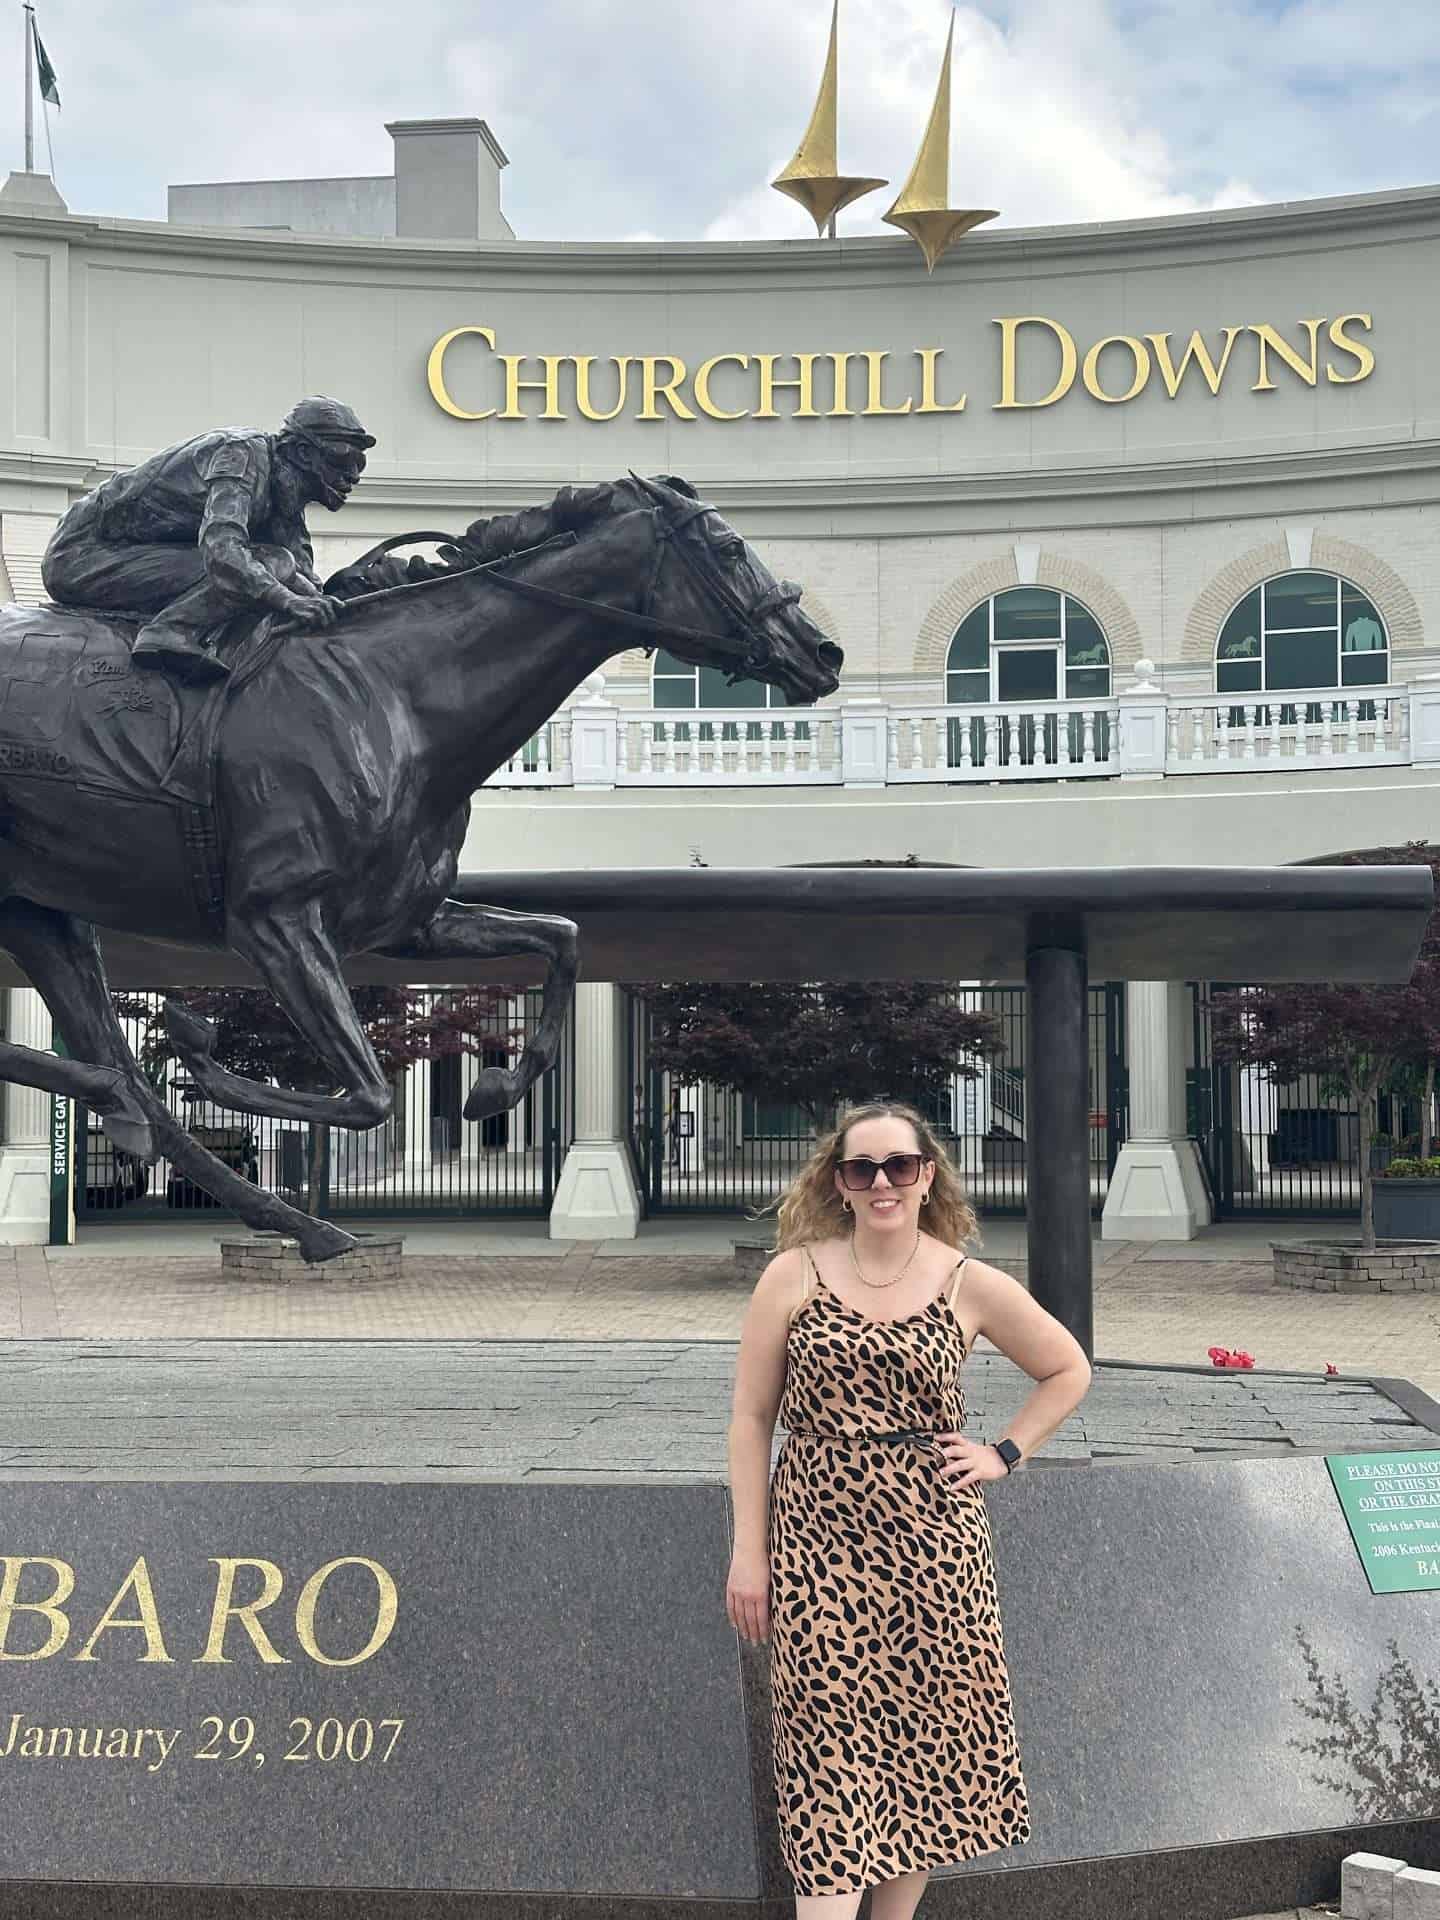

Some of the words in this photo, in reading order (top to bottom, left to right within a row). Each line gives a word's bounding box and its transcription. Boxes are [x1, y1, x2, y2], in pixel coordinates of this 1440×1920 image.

[426, 326, 967, 421] CHURCHILL
[991, 313, 1375, 410] DOWNS
[55, 1093, 66, 1120] GAT
[55, 1121, 66, 1175] SERVICE
[1346, 1463, 1394, 1477] PLEASE
[1397, 1463, 1417, 1474] DO
[1375, 1479, 1392, 1492] ON
[1394, 1478, 1425, 1491] THIS
[1360, 1497, 1379, 1509] OR
[1380, 1495, 1408, 1508] THE
[1368, 1520, 1389, 1533] This
[1400, 1519, 1414, 1531] the
[1372, 1544, 1397, 1557] 2006
[0, 1713, 183, 1772] January
[193, 1716, 266, 1769] 29,
[283, 1717, 405, 1763] 2007
